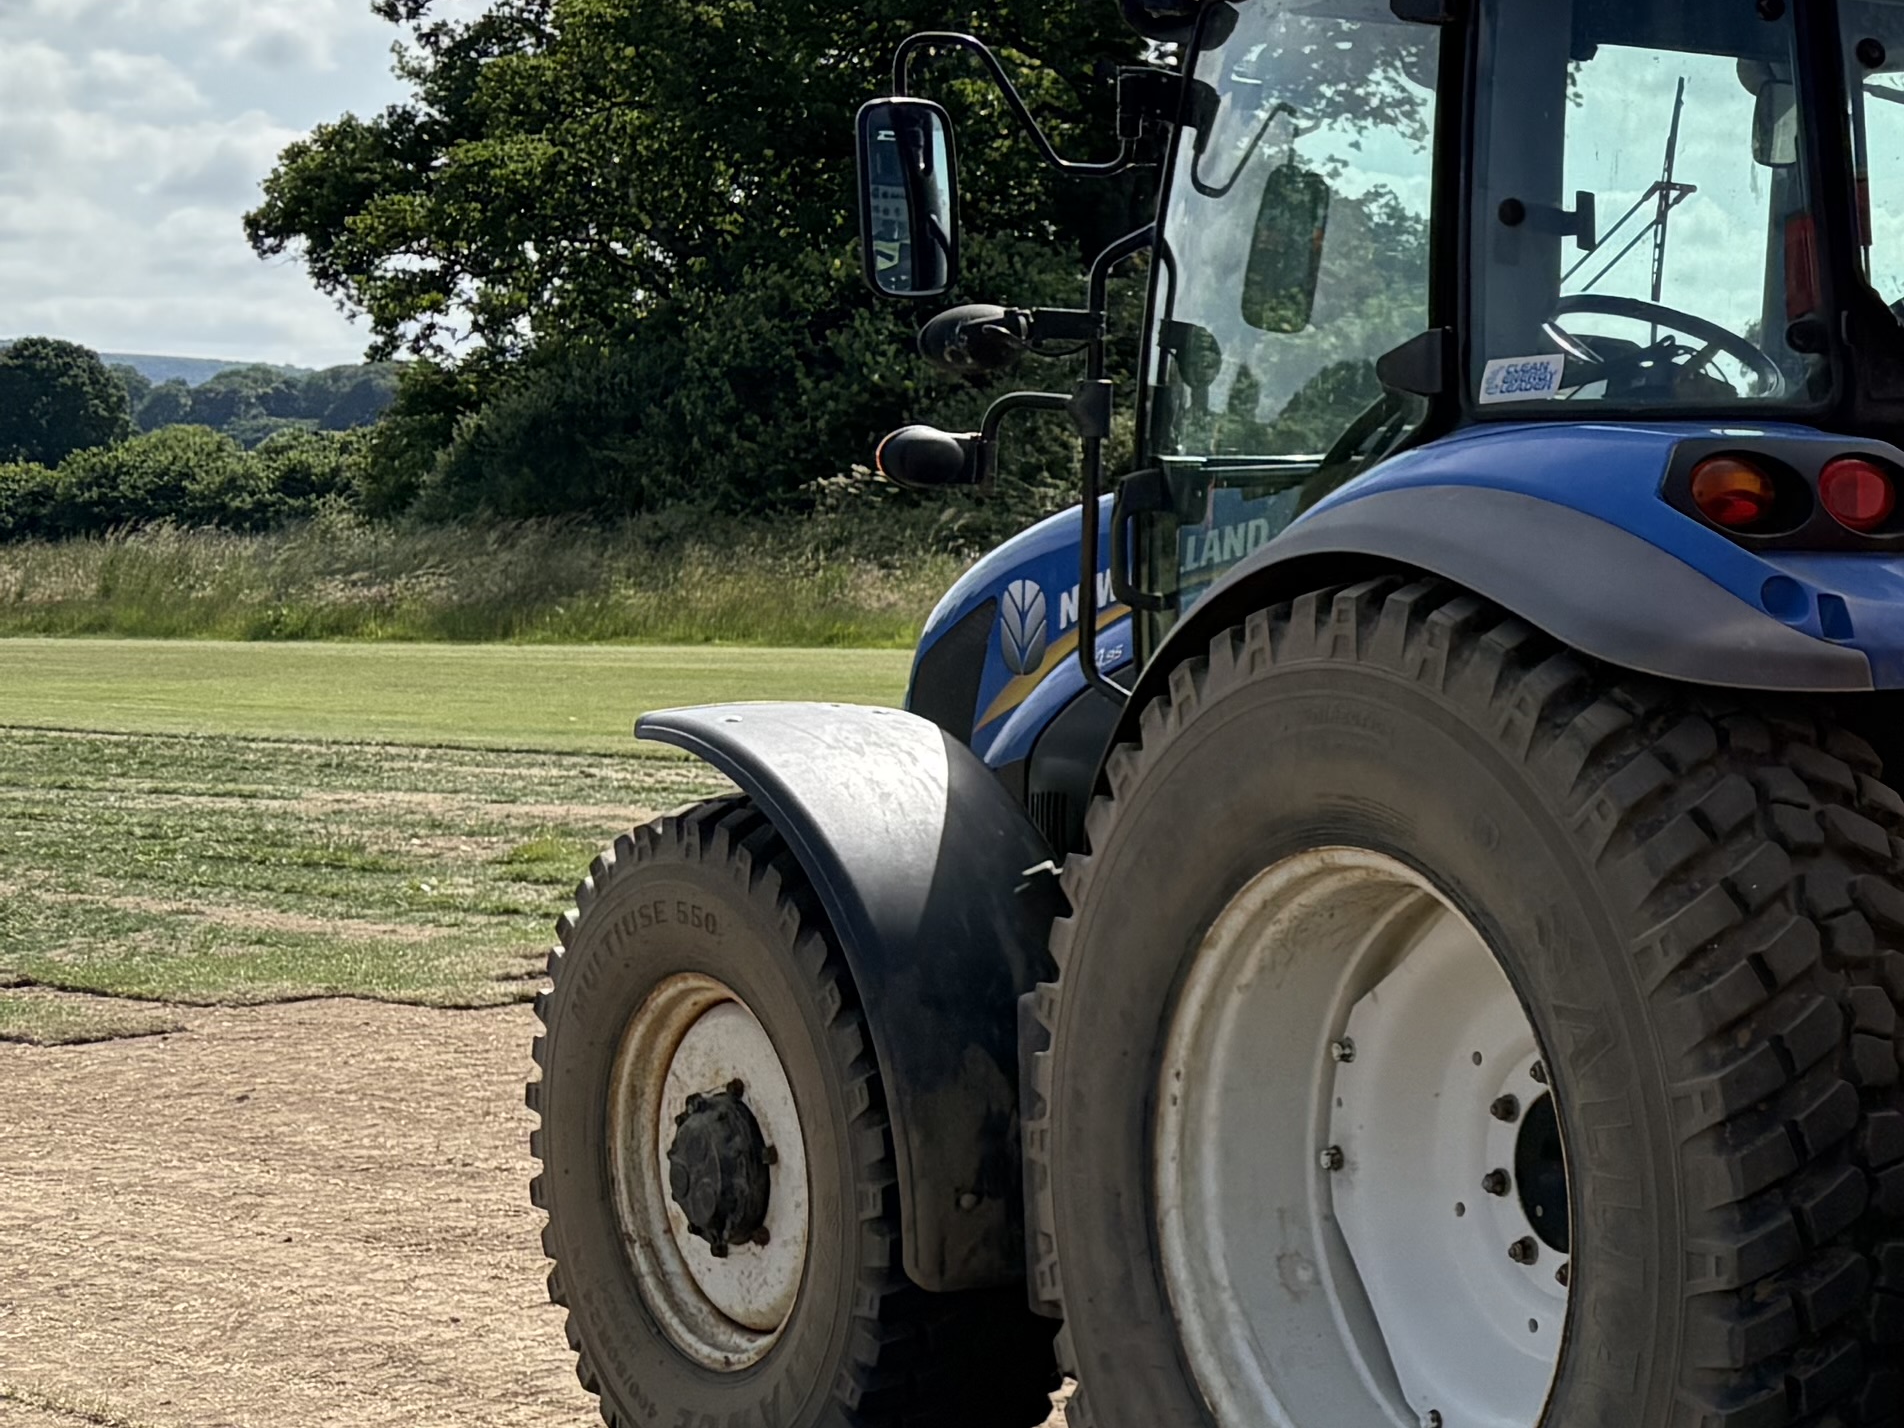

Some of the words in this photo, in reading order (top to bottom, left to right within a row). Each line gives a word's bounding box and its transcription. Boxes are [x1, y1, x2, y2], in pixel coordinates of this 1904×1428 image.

[1060, 568, 1117, 630] NW
[1180, 518, 1270, 572] LAND
[675, 900, 718, 936] 550
